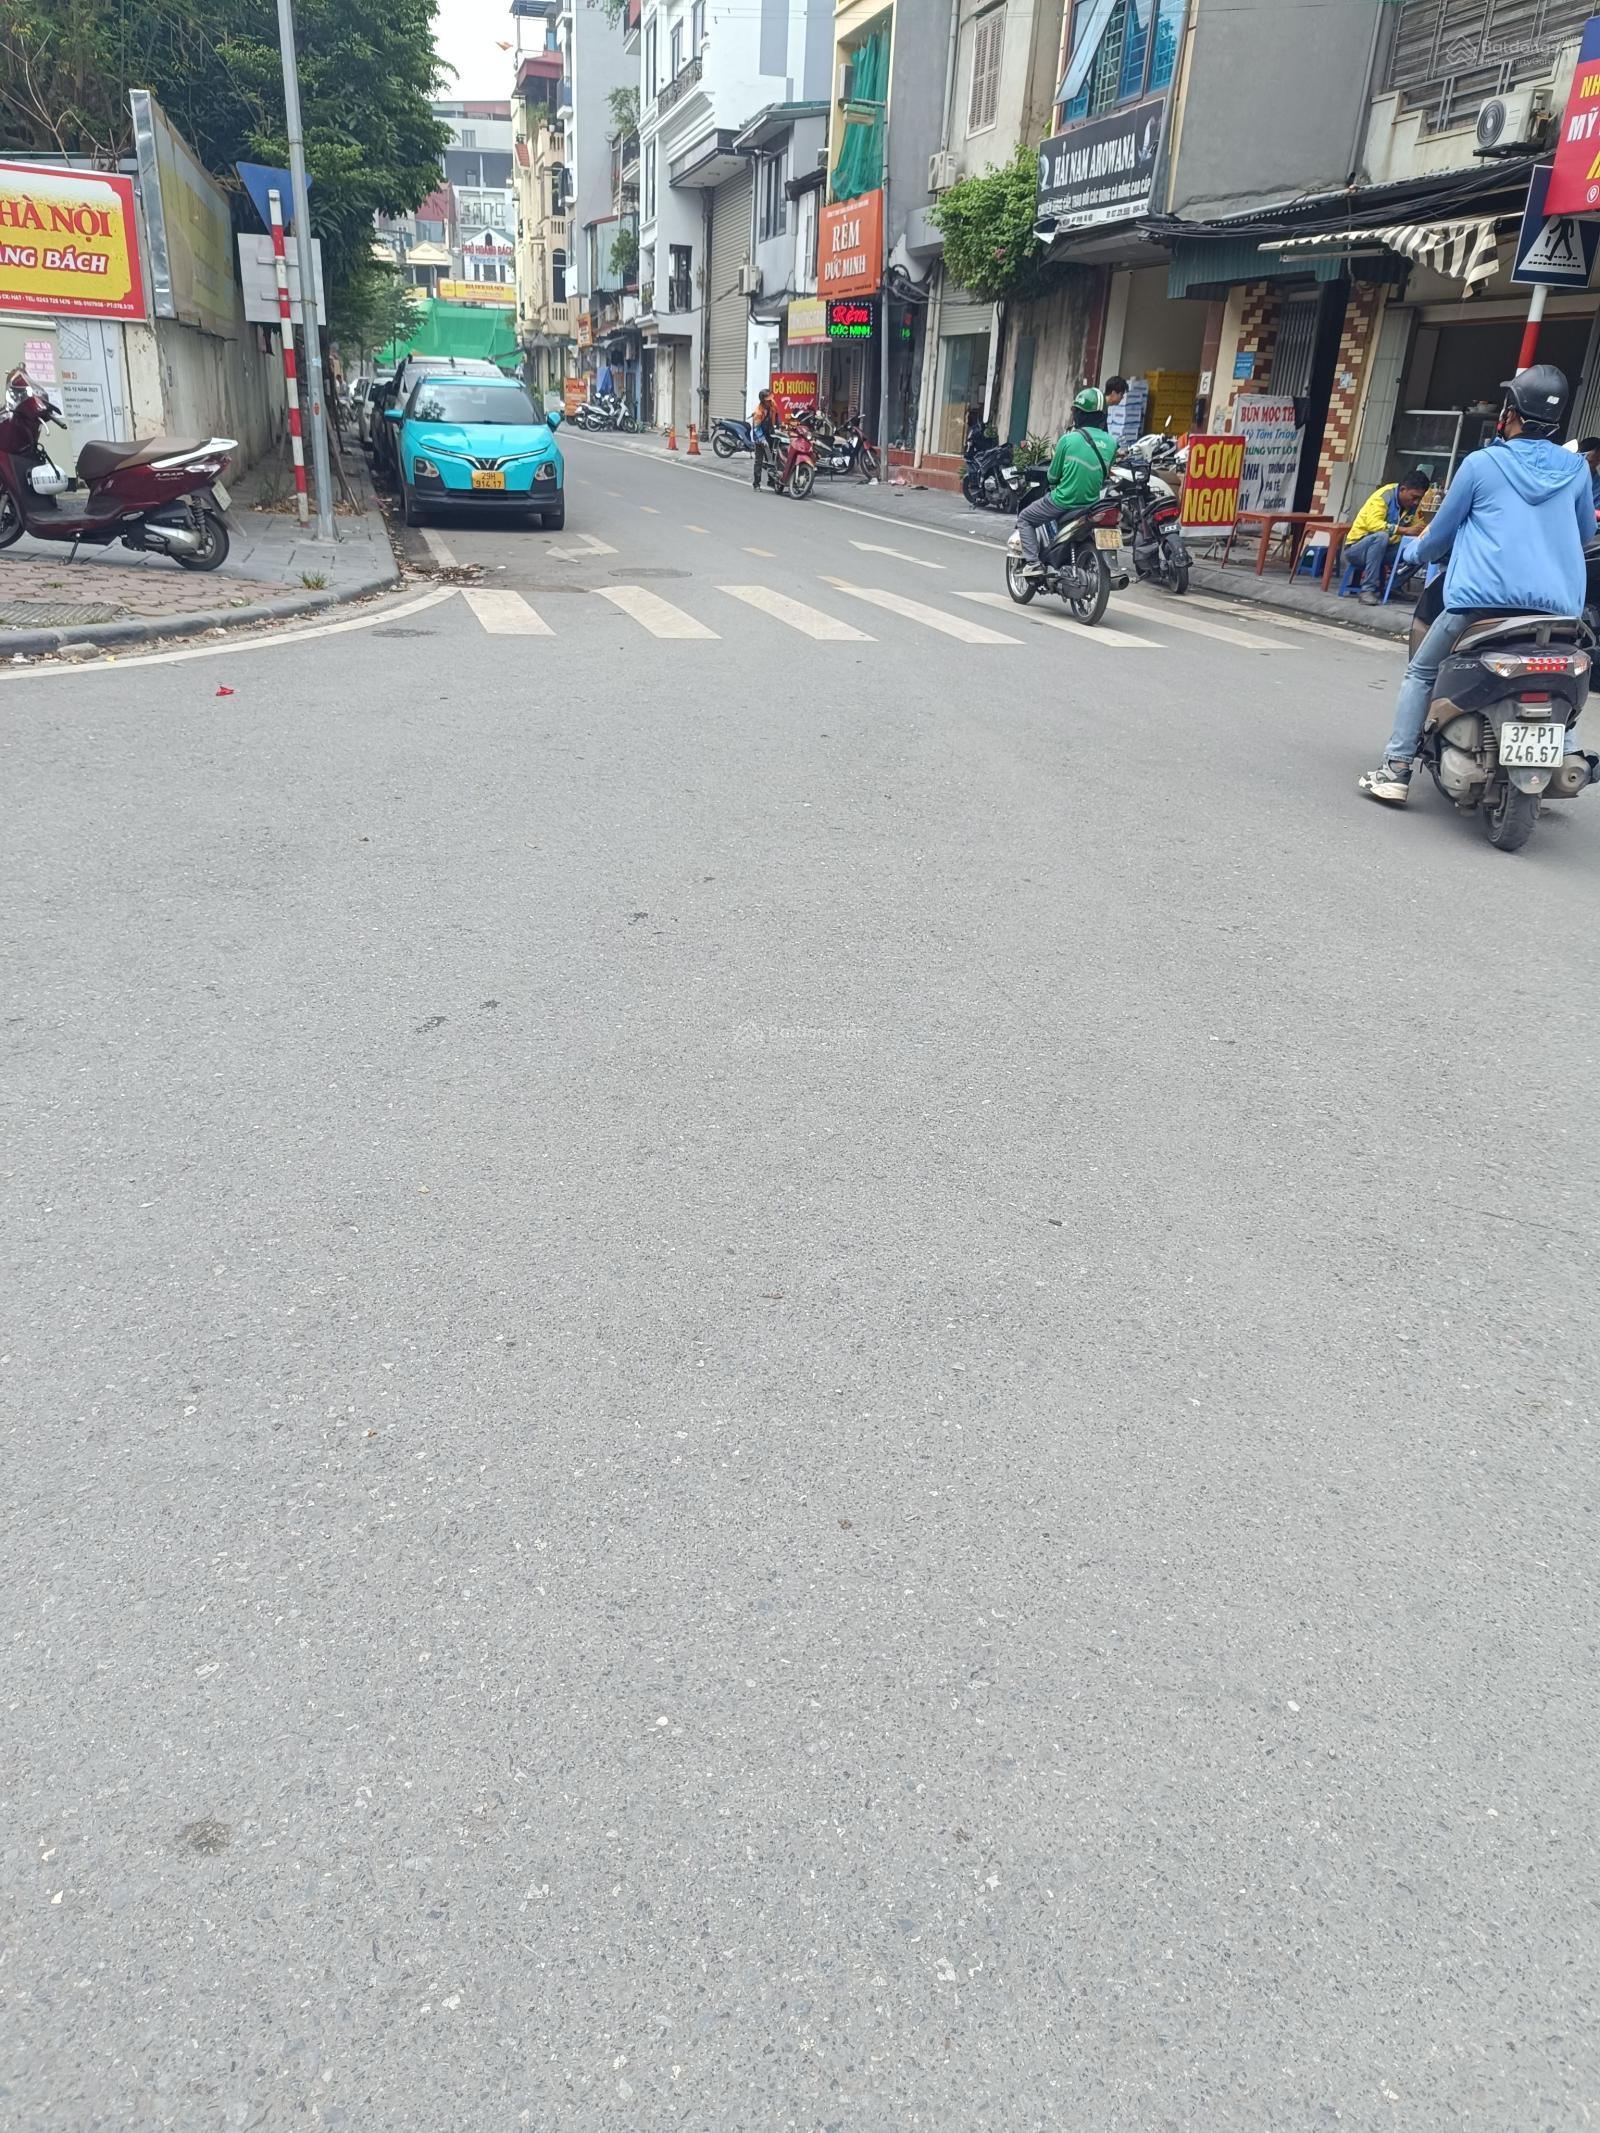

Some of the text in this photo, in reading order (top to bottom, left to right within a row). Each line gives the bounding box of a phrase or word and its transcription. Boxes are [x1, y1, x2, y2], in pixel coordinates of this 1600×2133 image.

[1069, 147, 1091, 184] NAM
[1089, 133, 1136, 179] AROWANA
[47, 202, 113, 243] NỘI
[832, 214, 861, 253] RÈM
[45, 247, 107, 273] BÁCH
[842, 254, 867, 279] MINH
[1241, 402, 1261, 423] BÚN
[1189, 441, 1242, 479] CƠM
[1183, 488, 1238, 523] NGON
[1511, 726, 1555, 745] 37-P1
